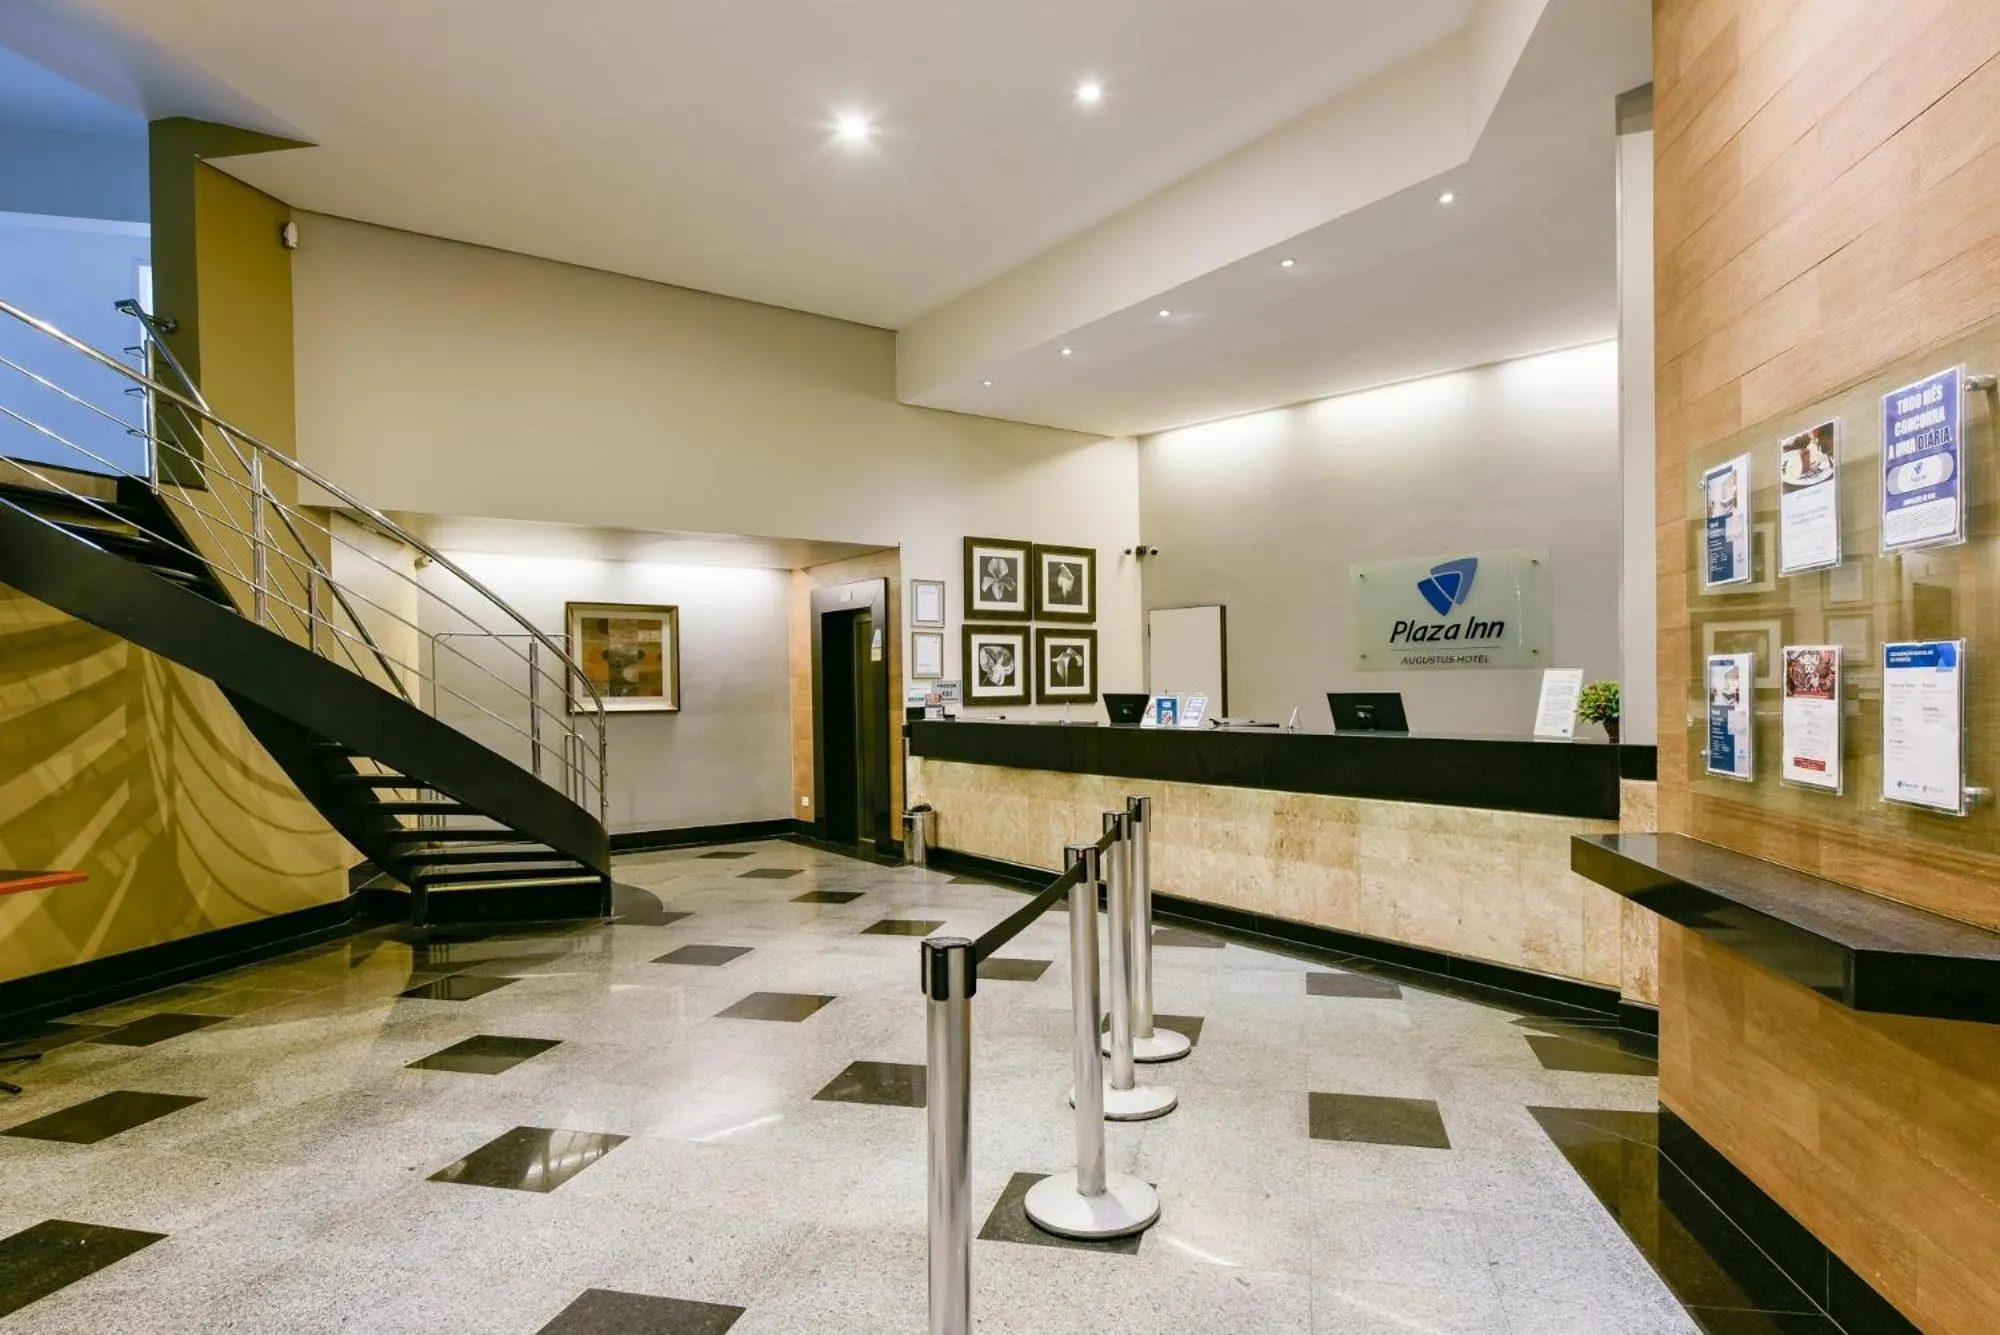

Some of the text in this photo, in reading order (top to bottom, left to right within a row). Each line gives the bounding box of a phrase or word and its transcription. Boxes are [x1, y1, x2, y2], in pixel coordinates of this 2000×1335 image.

[1390, 616, 1504, 643] Plaza Inn
[1400, 654, 1489, 665] AUGUSTUS HOTEL
